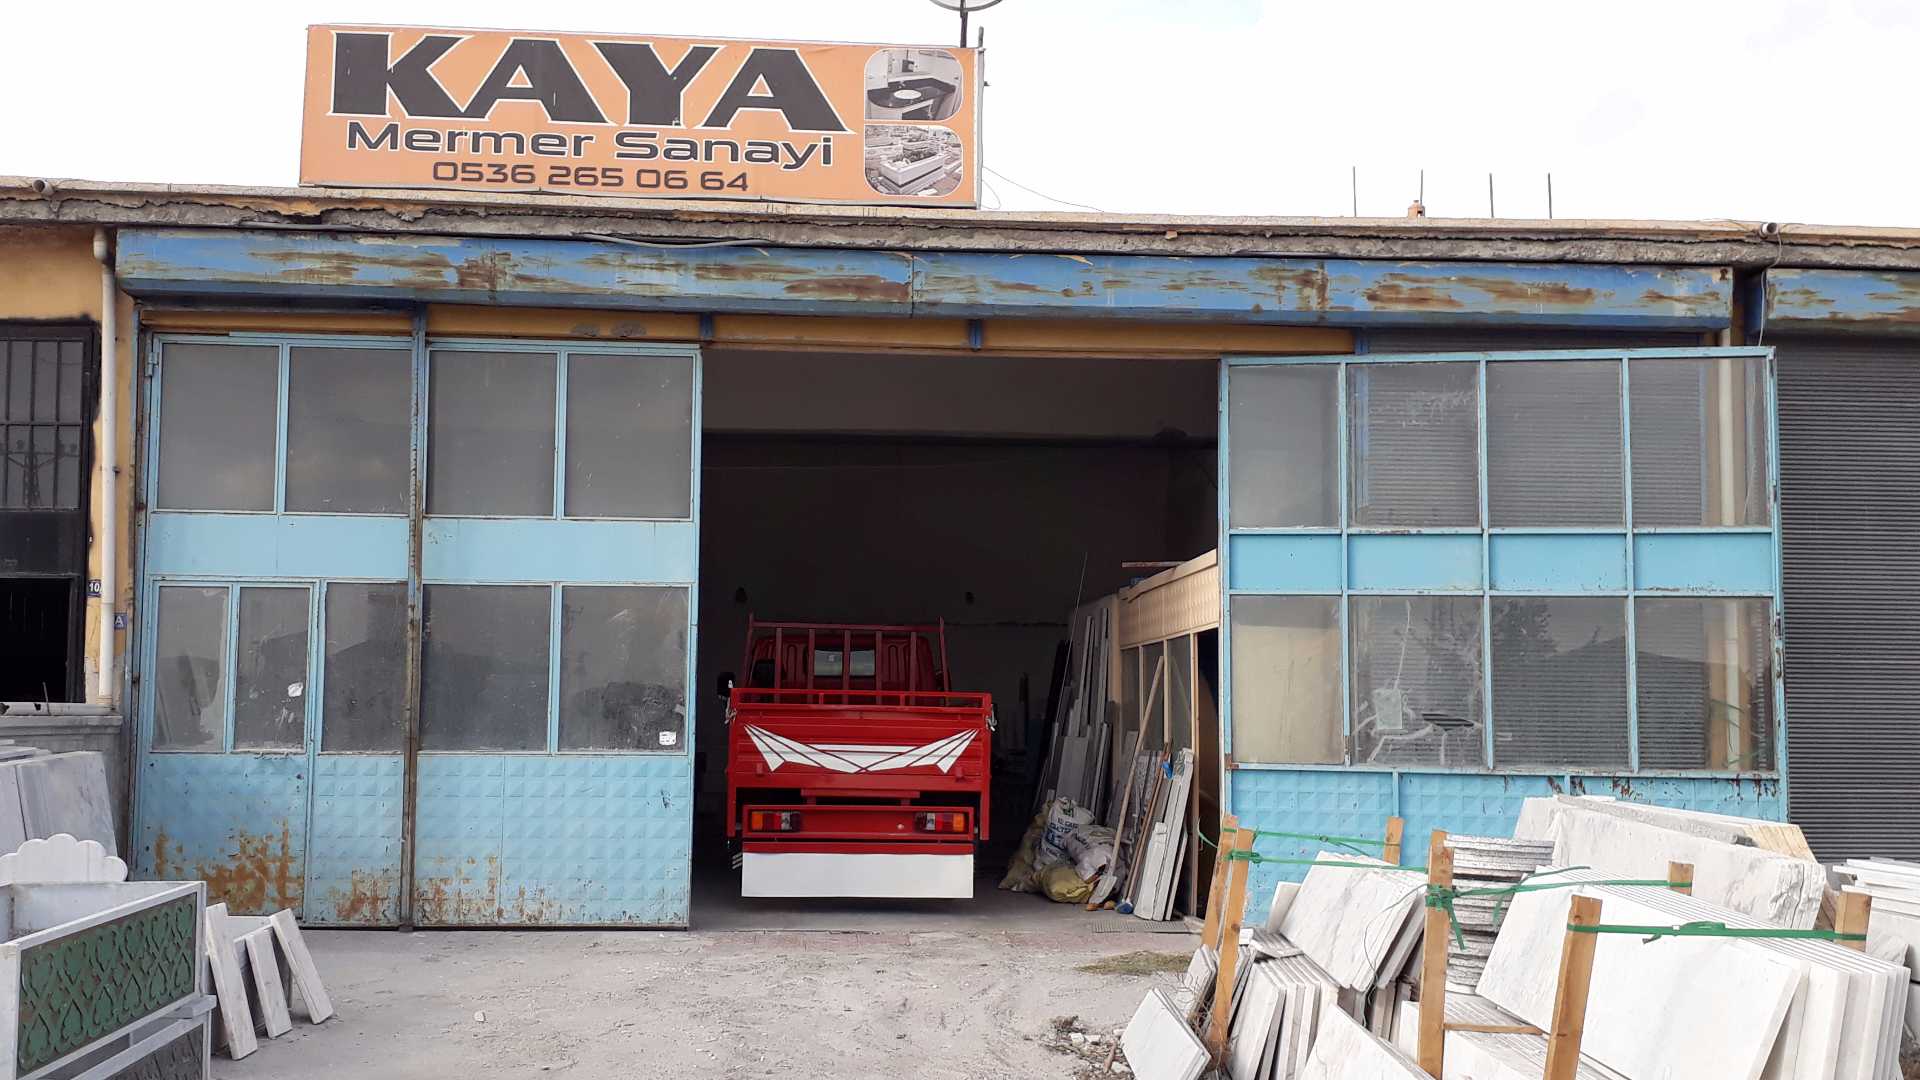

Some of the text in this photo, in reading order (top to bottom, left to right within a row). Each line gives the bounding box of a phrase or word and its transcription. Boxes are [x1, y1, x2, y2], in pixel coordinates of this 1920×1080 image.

[330, 31, 850, 133] KAYA
[346, 121, 833, 169] Mermer Sanayi
[432, 161, 750, 192] 0536 265 06 64
